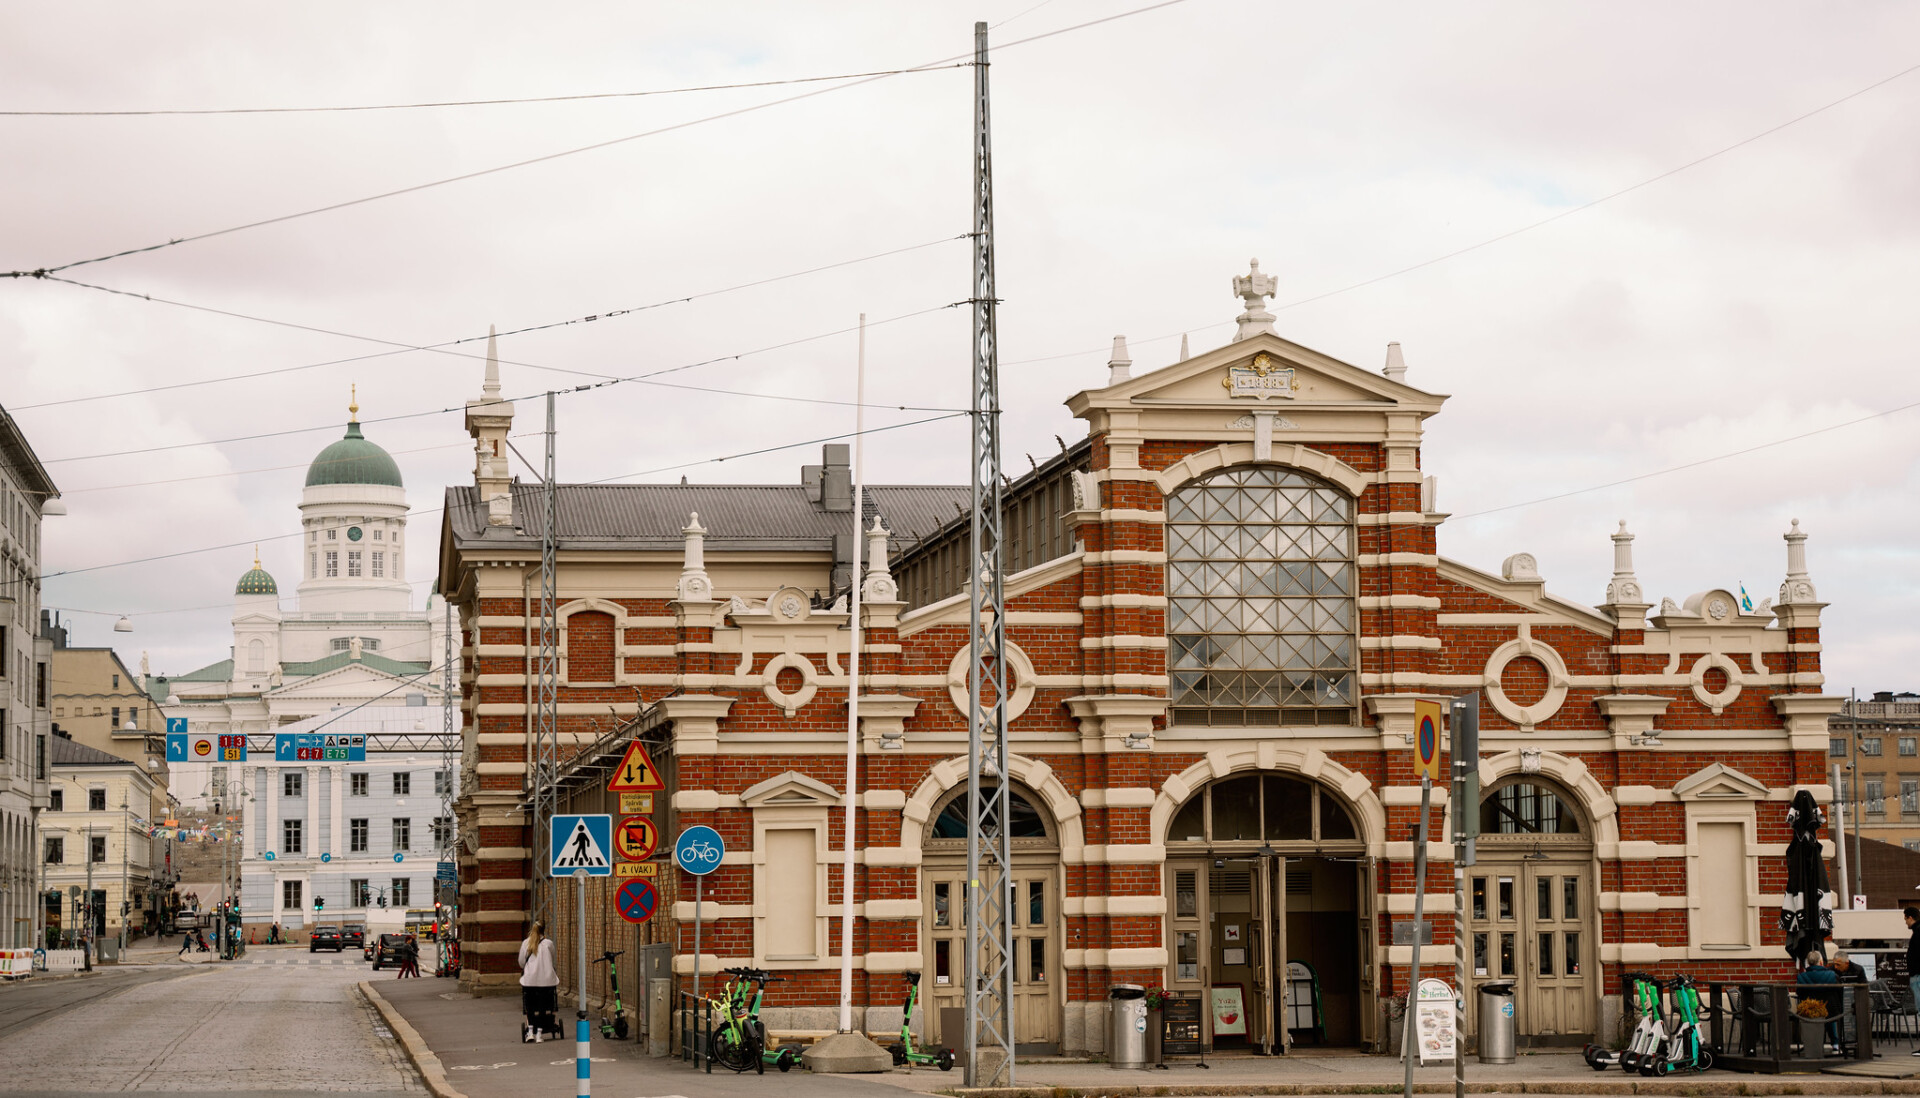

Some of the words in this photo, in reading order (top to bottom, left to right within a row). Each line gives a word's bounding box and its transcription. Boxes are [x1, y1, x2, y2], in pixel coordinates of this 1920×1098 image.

[223, 737, 228, 746] 1
[238, 737, 243, 746] 3
[227, 751, 239, 759] 51
[300, 749, 307, 758] 4
[314, 749, 320, 758] 7
[326, 749, 333, 758] E
[335, 749, 346, 758] 75
[621, 866, 627, 874] A
[630, 865, 653, 875] (VAK)
